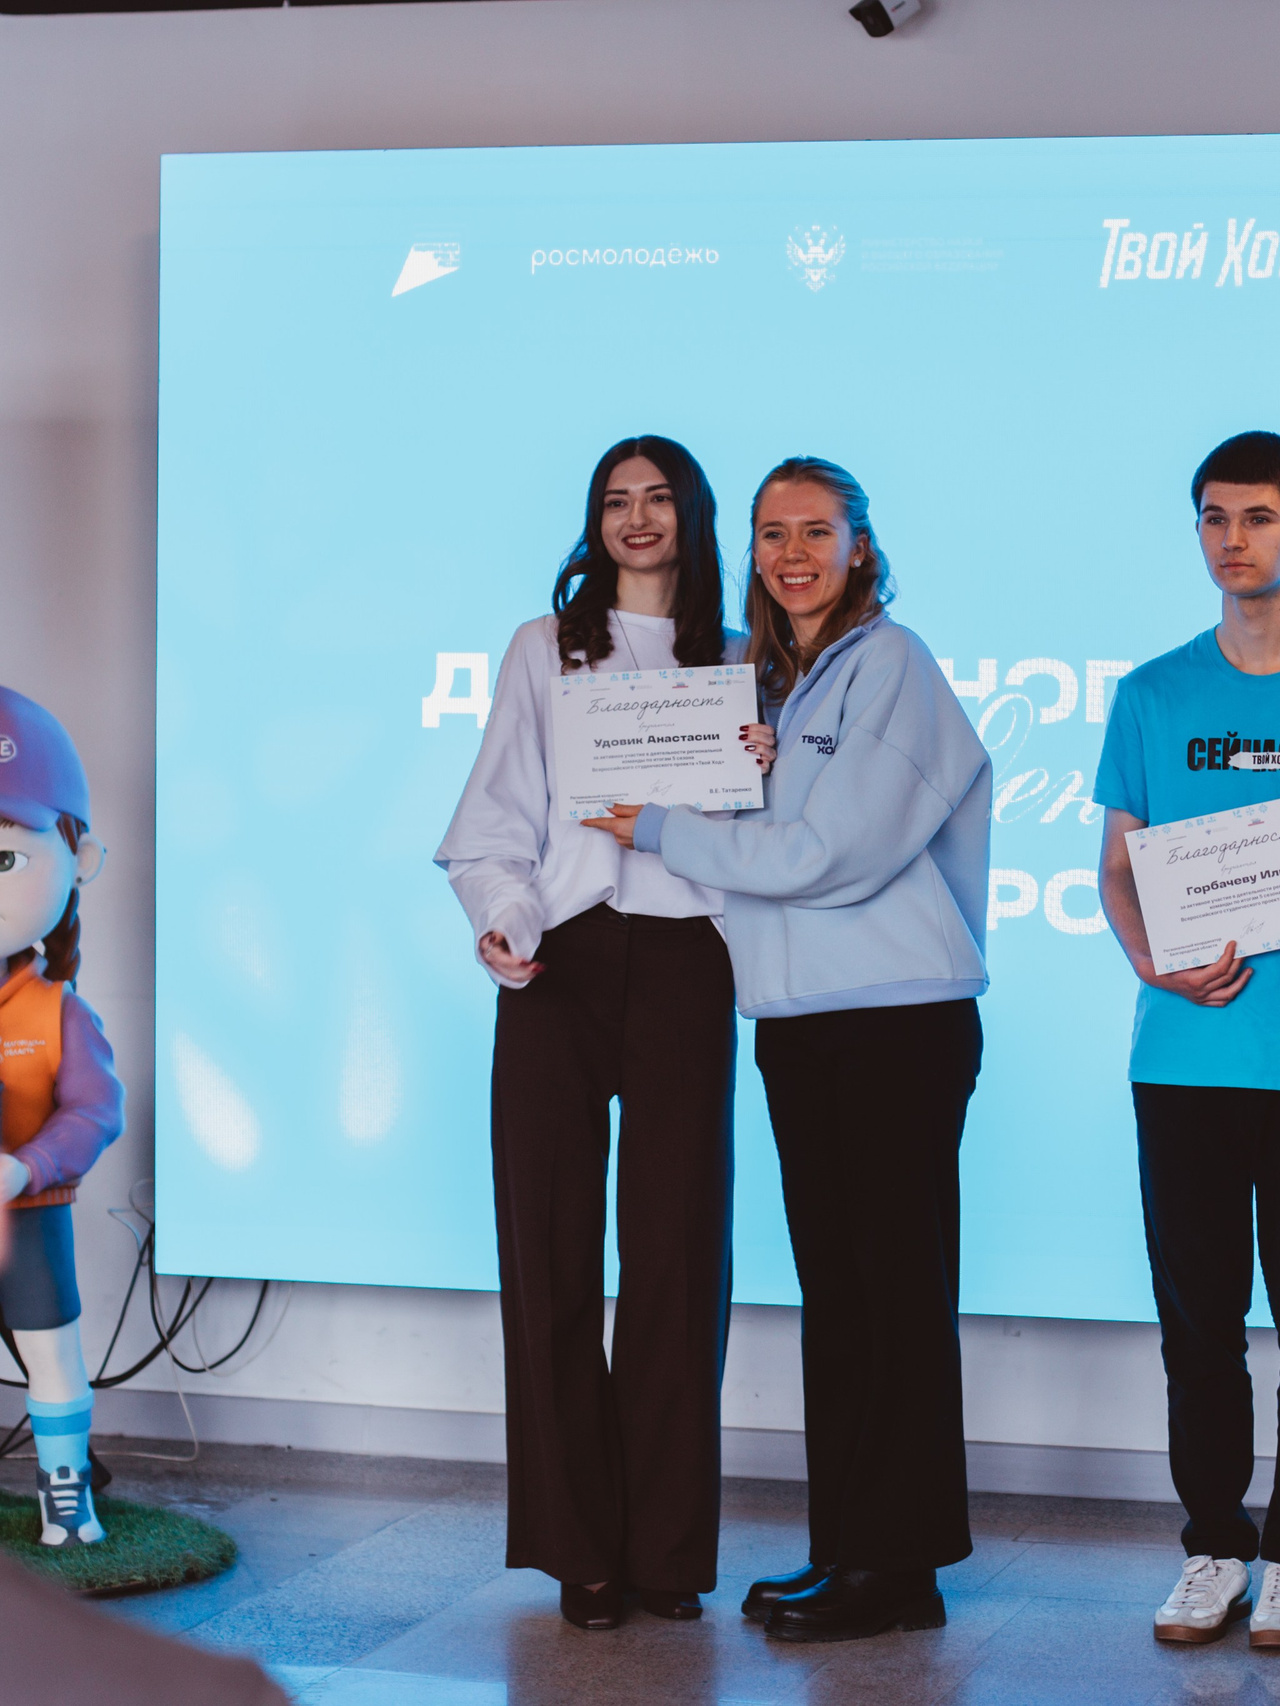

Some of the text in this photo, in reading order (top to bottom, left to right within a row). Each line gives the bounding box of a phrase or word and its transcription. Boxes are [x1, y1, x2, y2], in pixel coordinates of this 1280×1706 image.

[531, 242, 719, 275] росмолодёжь
[587, 697, 723, 720] Благодарность
[594, 733, 720, 749] Удовик Анастасии
[802, 734, 832, 746] ТВОЙ
[1252, 752, 1270, 766] ТВОЙ
[1186, 875, 1257, 895] Горбачеву
